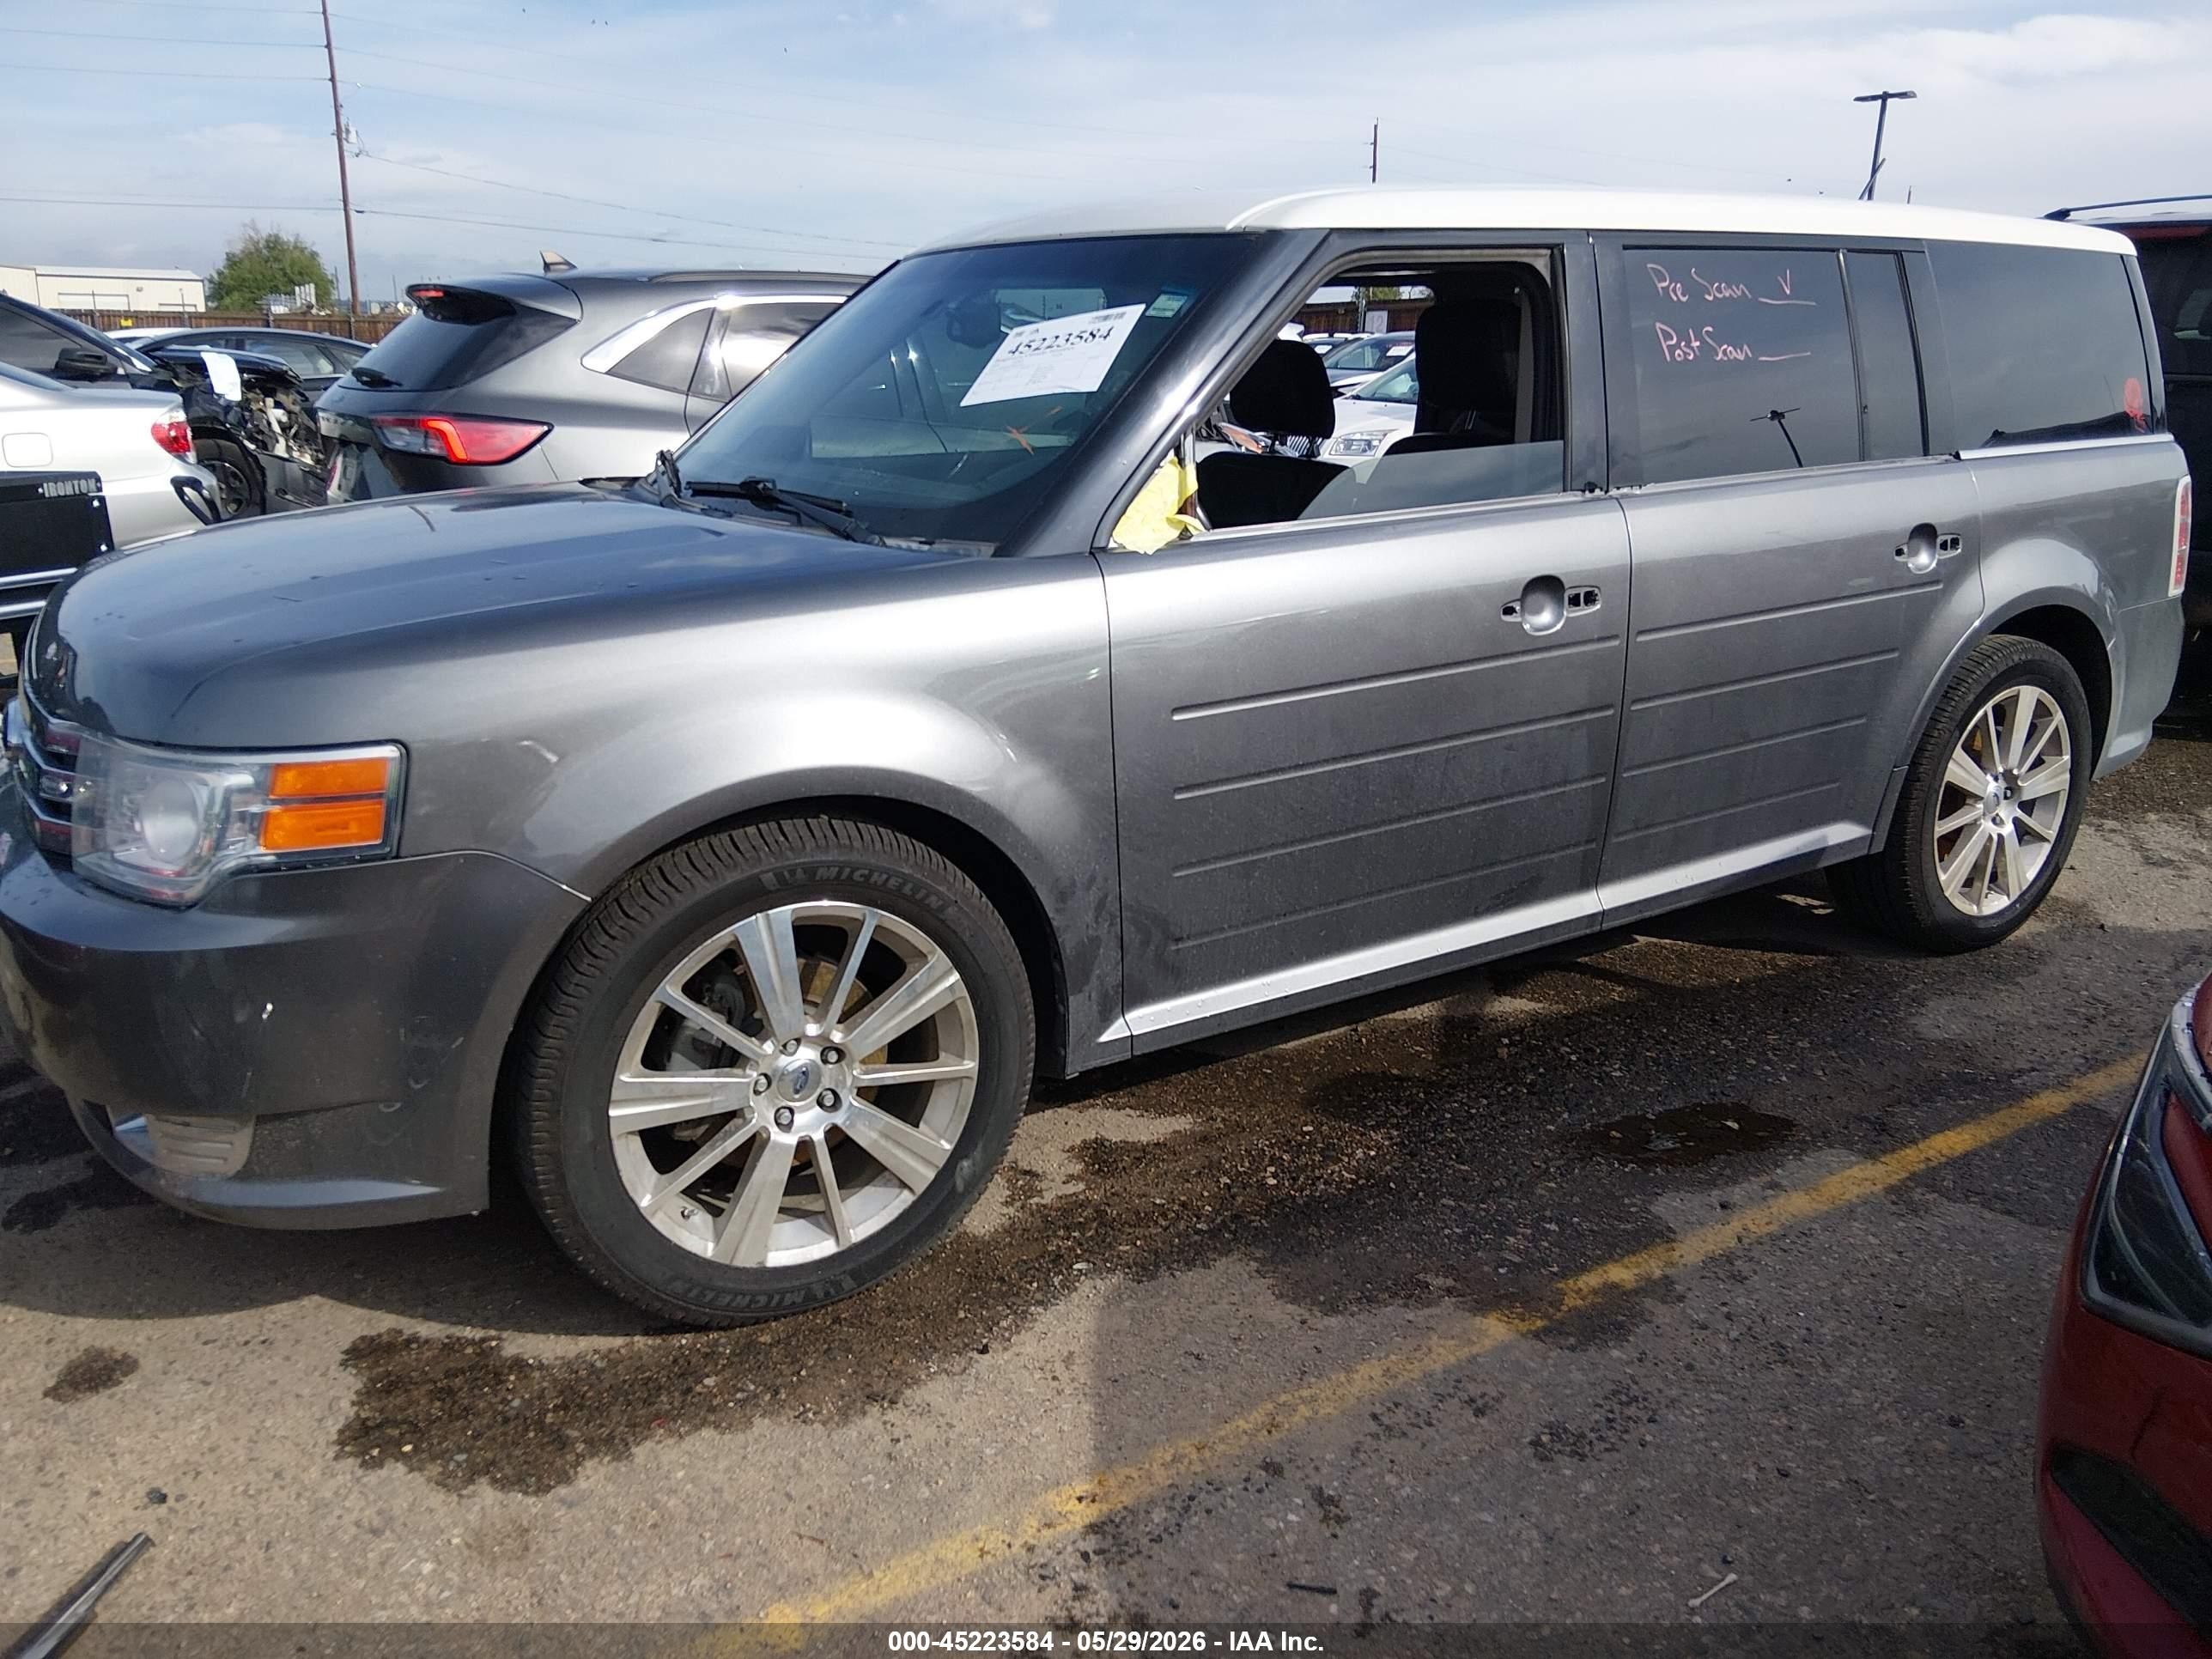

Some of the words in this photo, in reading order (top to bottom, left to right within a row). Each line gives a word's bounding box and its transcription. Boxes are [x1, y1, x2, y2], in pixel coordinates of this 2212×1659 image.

[1646, 263, 1689, 303] Pre
[1690, 267, 1753, 301] Scan
[1007, 325, 1115, 356] 45223584
[1655, 321, 1701, 363] Post
[1701, 325, 1753, 362] Scan
[43, 478, 98, 498] IRONTON
[814, 866, 945, 910] MICHELIN
